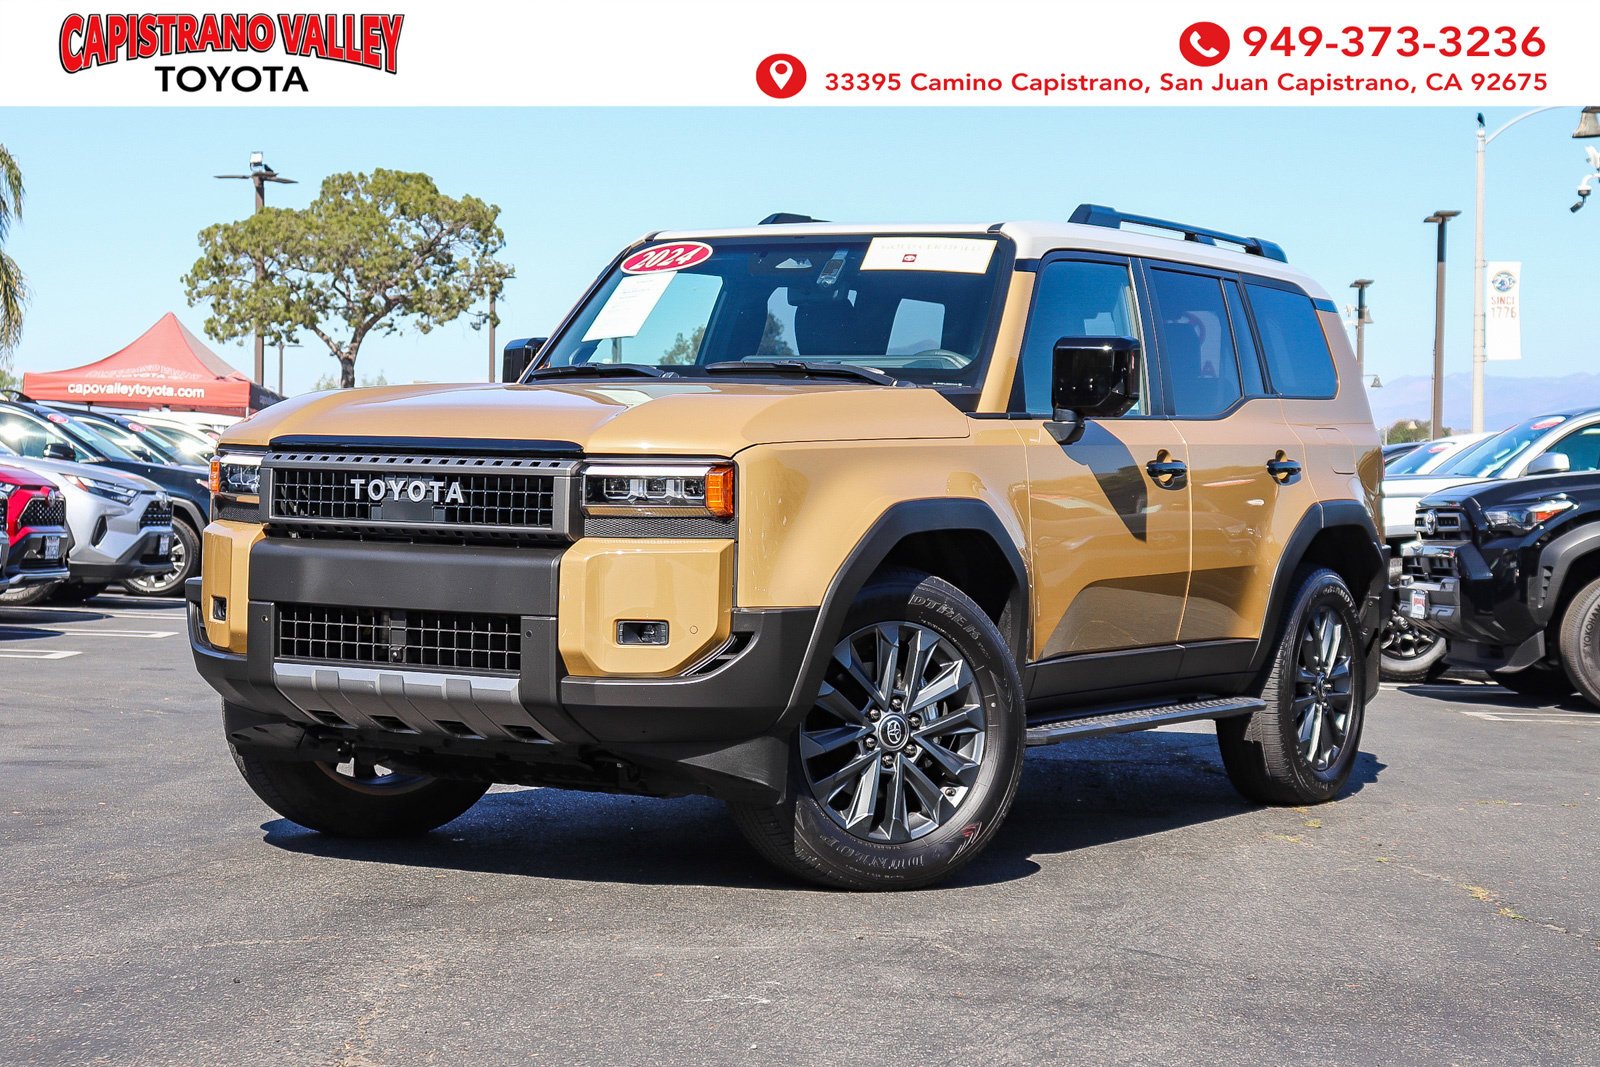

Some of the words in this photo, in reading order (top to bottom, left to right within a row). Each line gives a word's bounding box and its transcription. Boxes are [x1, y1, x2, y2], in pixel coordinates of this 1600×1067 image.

[628, 246, 704, 270] 2024
[1491, 306, 1516, 318] 1776
[67, 382, 205, 398] capovalleytoyota.com
[350, 478, 465, 504] TOYOTA
